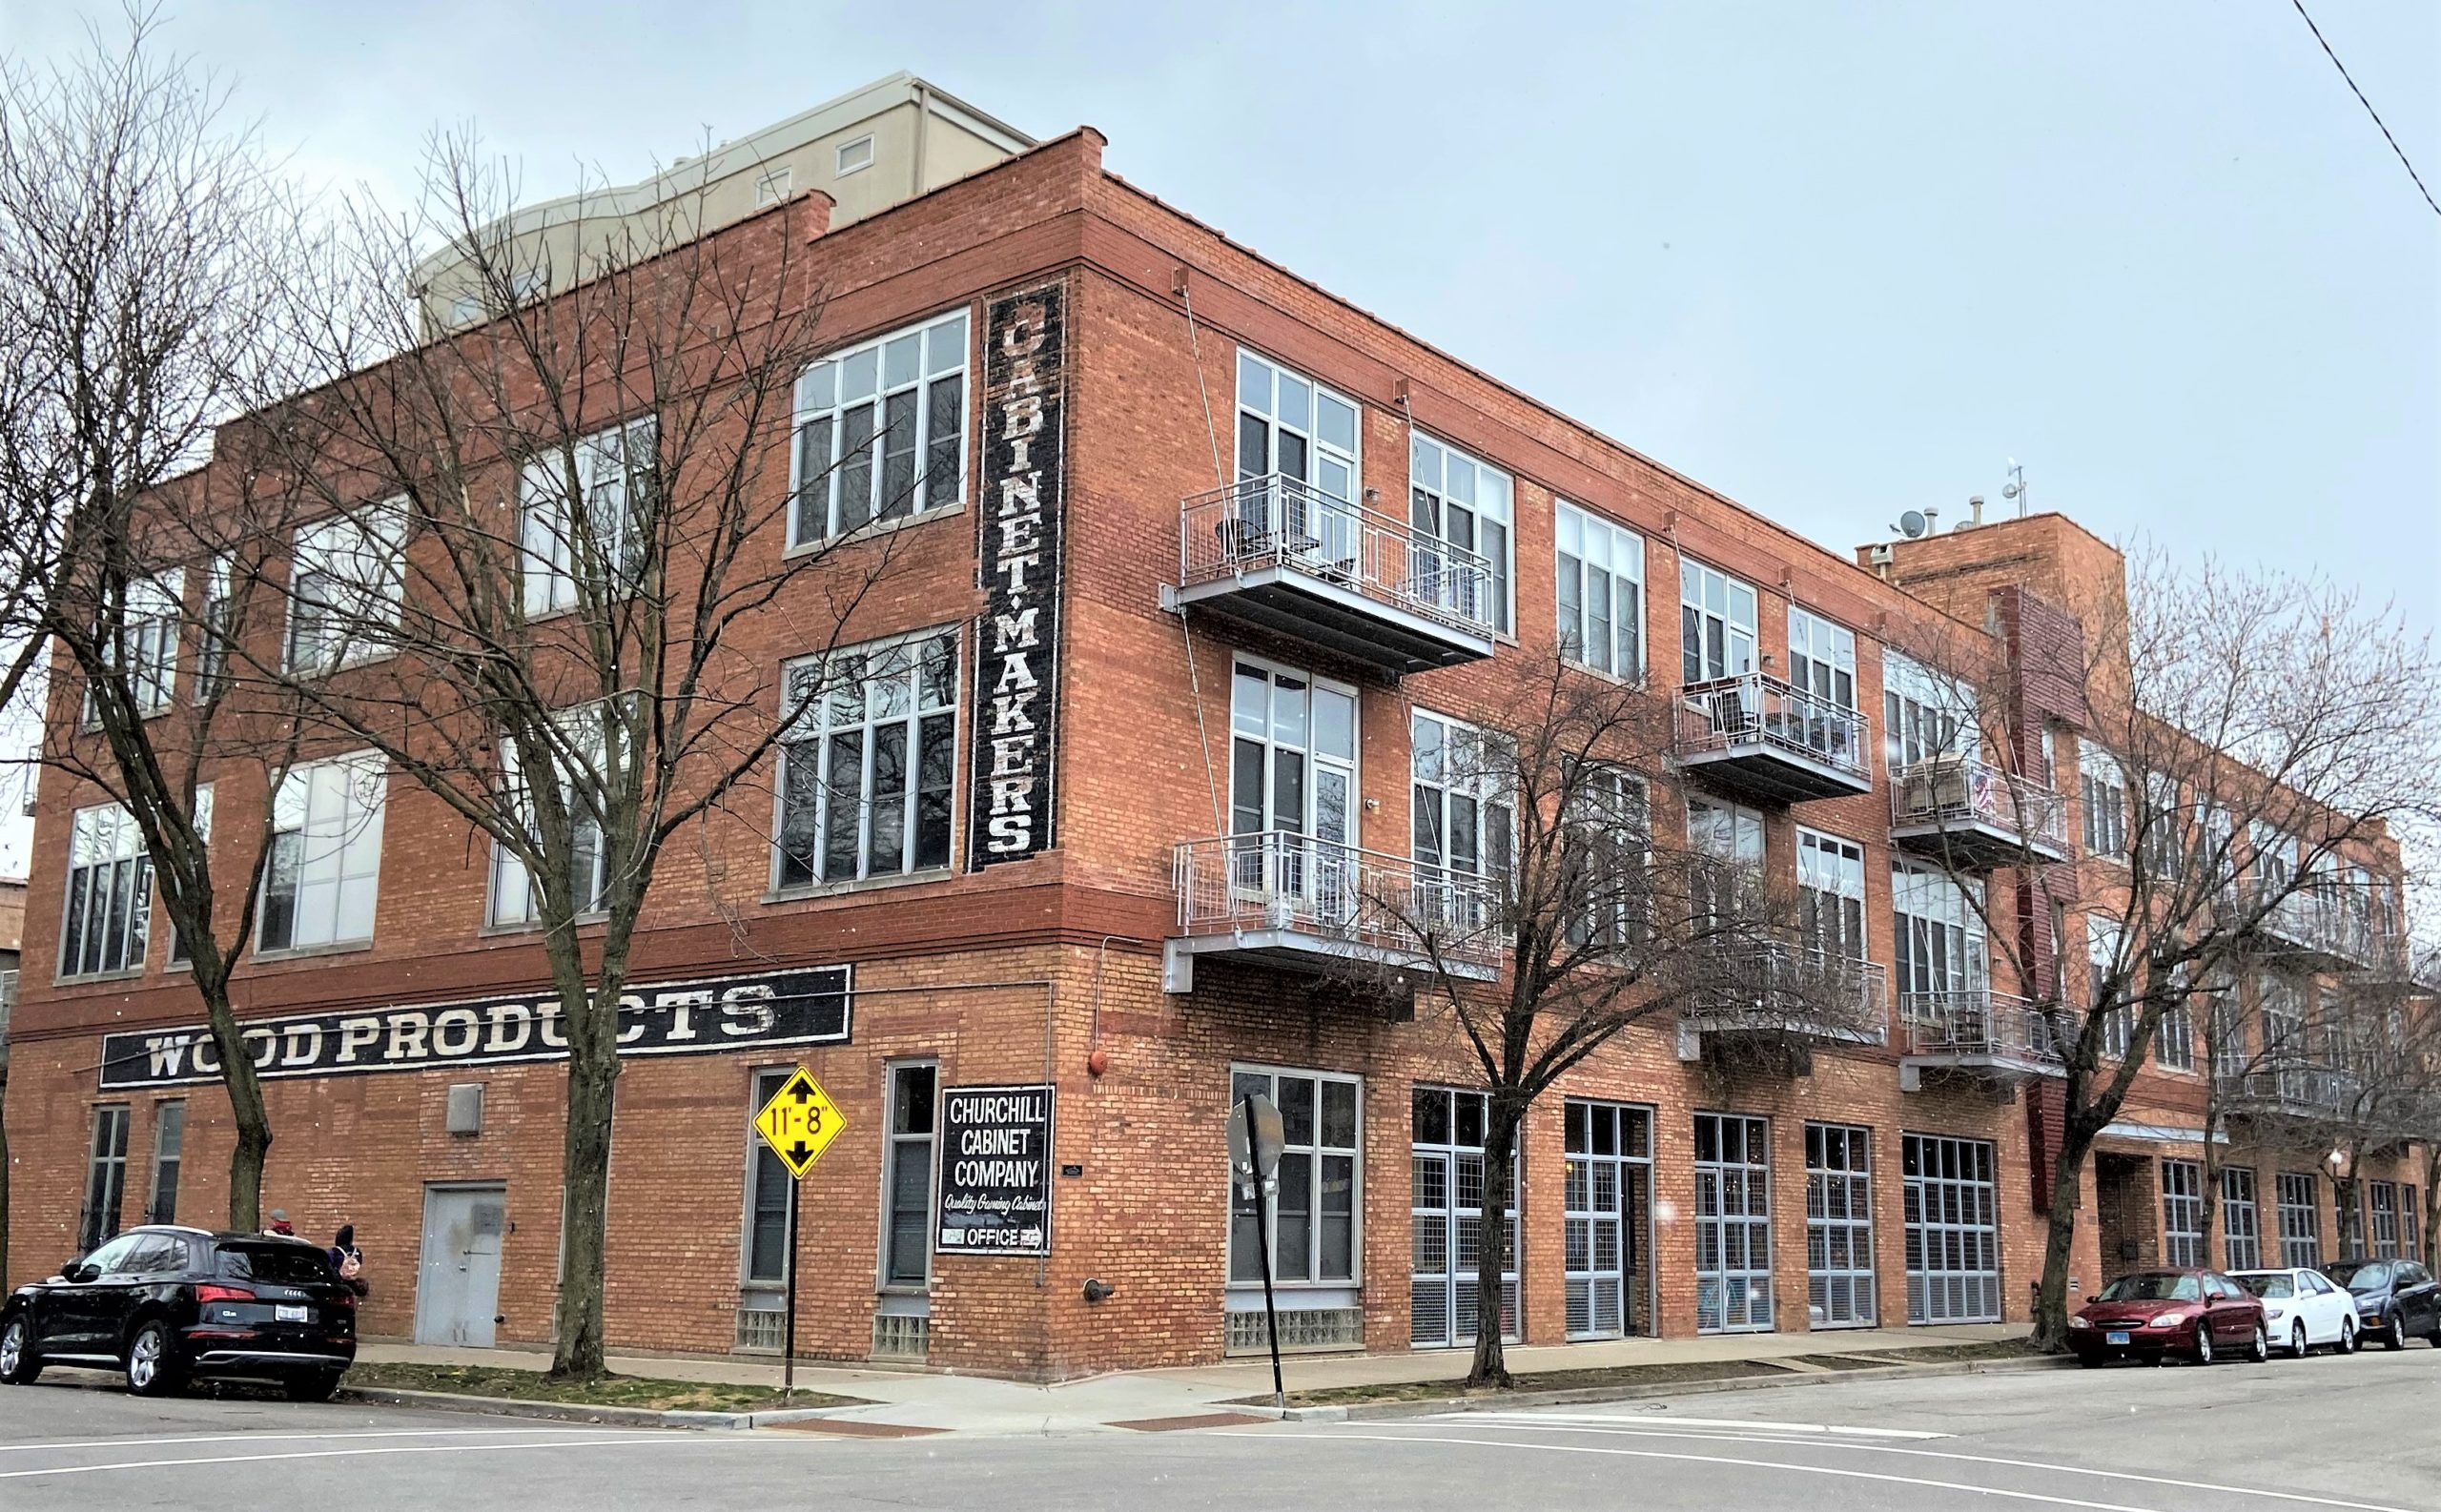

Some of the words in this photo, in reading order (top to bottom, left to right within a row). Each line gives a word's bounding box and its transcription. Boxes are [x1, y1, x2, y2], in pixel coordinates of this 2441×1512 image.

[996, 303, 1047, 595] CABINET
[987, 607, 1040, 853] MAKERS
[146, 1024, 322, 1076] WOOD
[336, 984, 776, 1063] PRODUCTS
[950, 1095, 1045, 1124] CHURCHILL
[961, 1128, 1031, 1155] CABINET
[954, 1160, 1038, 1188] COMPANY
[944, 1193, 976, 1215] Quality
[977, 1194, 1011, 1216] Gaming
[967, 1228, 1018, 1246] OFFICE
